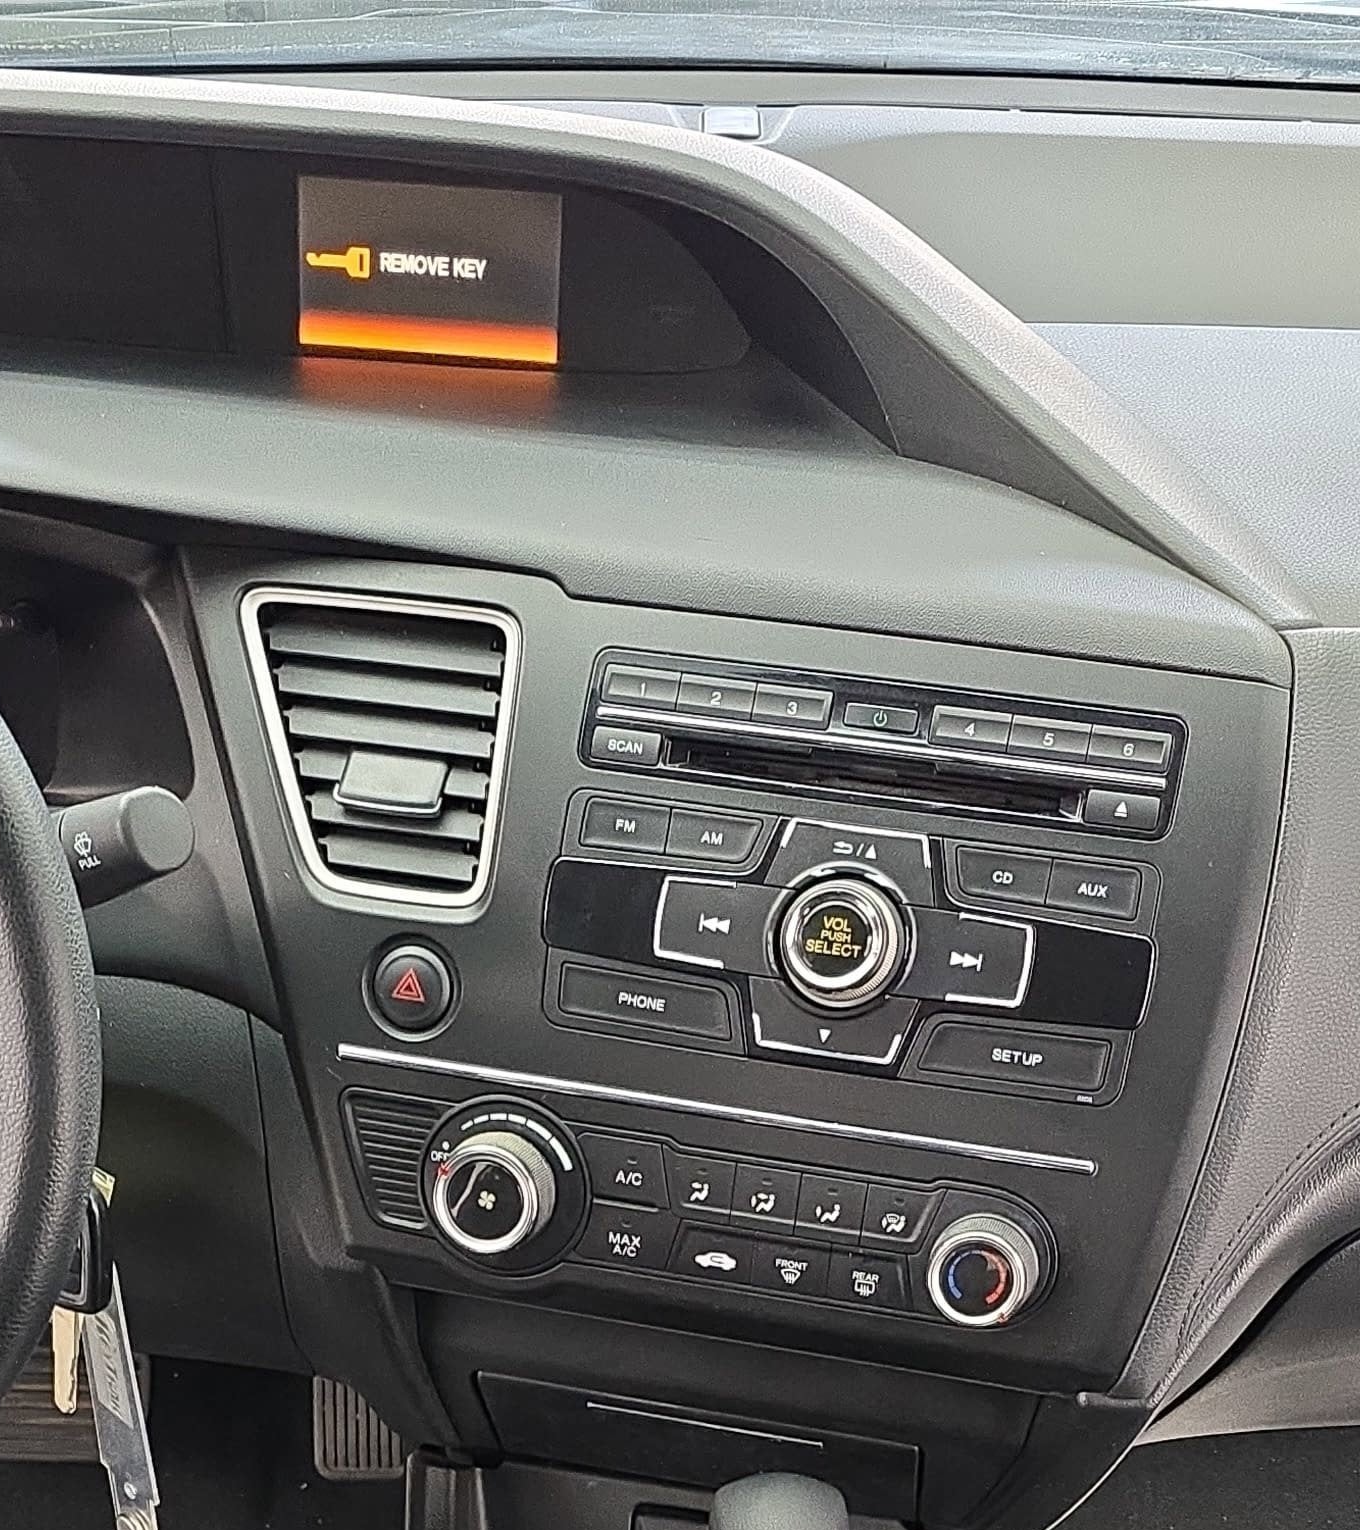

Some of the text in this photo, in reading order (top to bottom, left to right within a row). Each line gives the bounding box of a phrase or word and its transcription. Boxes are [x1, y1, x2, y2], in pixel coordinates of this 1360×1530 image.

[379, 252, 487, 280] REMOVE KEY
[638, 681, 647, 697] 1
[710, 690, 723, 706] 2
[785, 700, 799, 717] 3
[963, 721, 977, 738] 4
[607, 737, 644, 757] SCAN
[1042, 731, 1055, 747] 5
[1122, 742, 1135, 758] 6
[614, 817, 637, 836] FM
[699, 829, 725, 848] AM
[77, 854, 102, 871] PULL
[991, 869, 1015, 887] CD
[1077, 880, 1109, 901] AUX
[822, 914, 853, 934] VOL
[820, 929, 852, 945] PUSH
[804, 938, 863, 961] SELECT
[617, 992, 667, 1014] PHONE
[991, 1047, 1044, 1070] SETUP
[614, 1169, 643, 1187] A/C
[607, 1231, 642, 1250] MAX
[611, 1242, 640, 1259] A/C
[774, 1257, 809, 1275] FRONT
[852, 1271, 880, 1286] REAR
